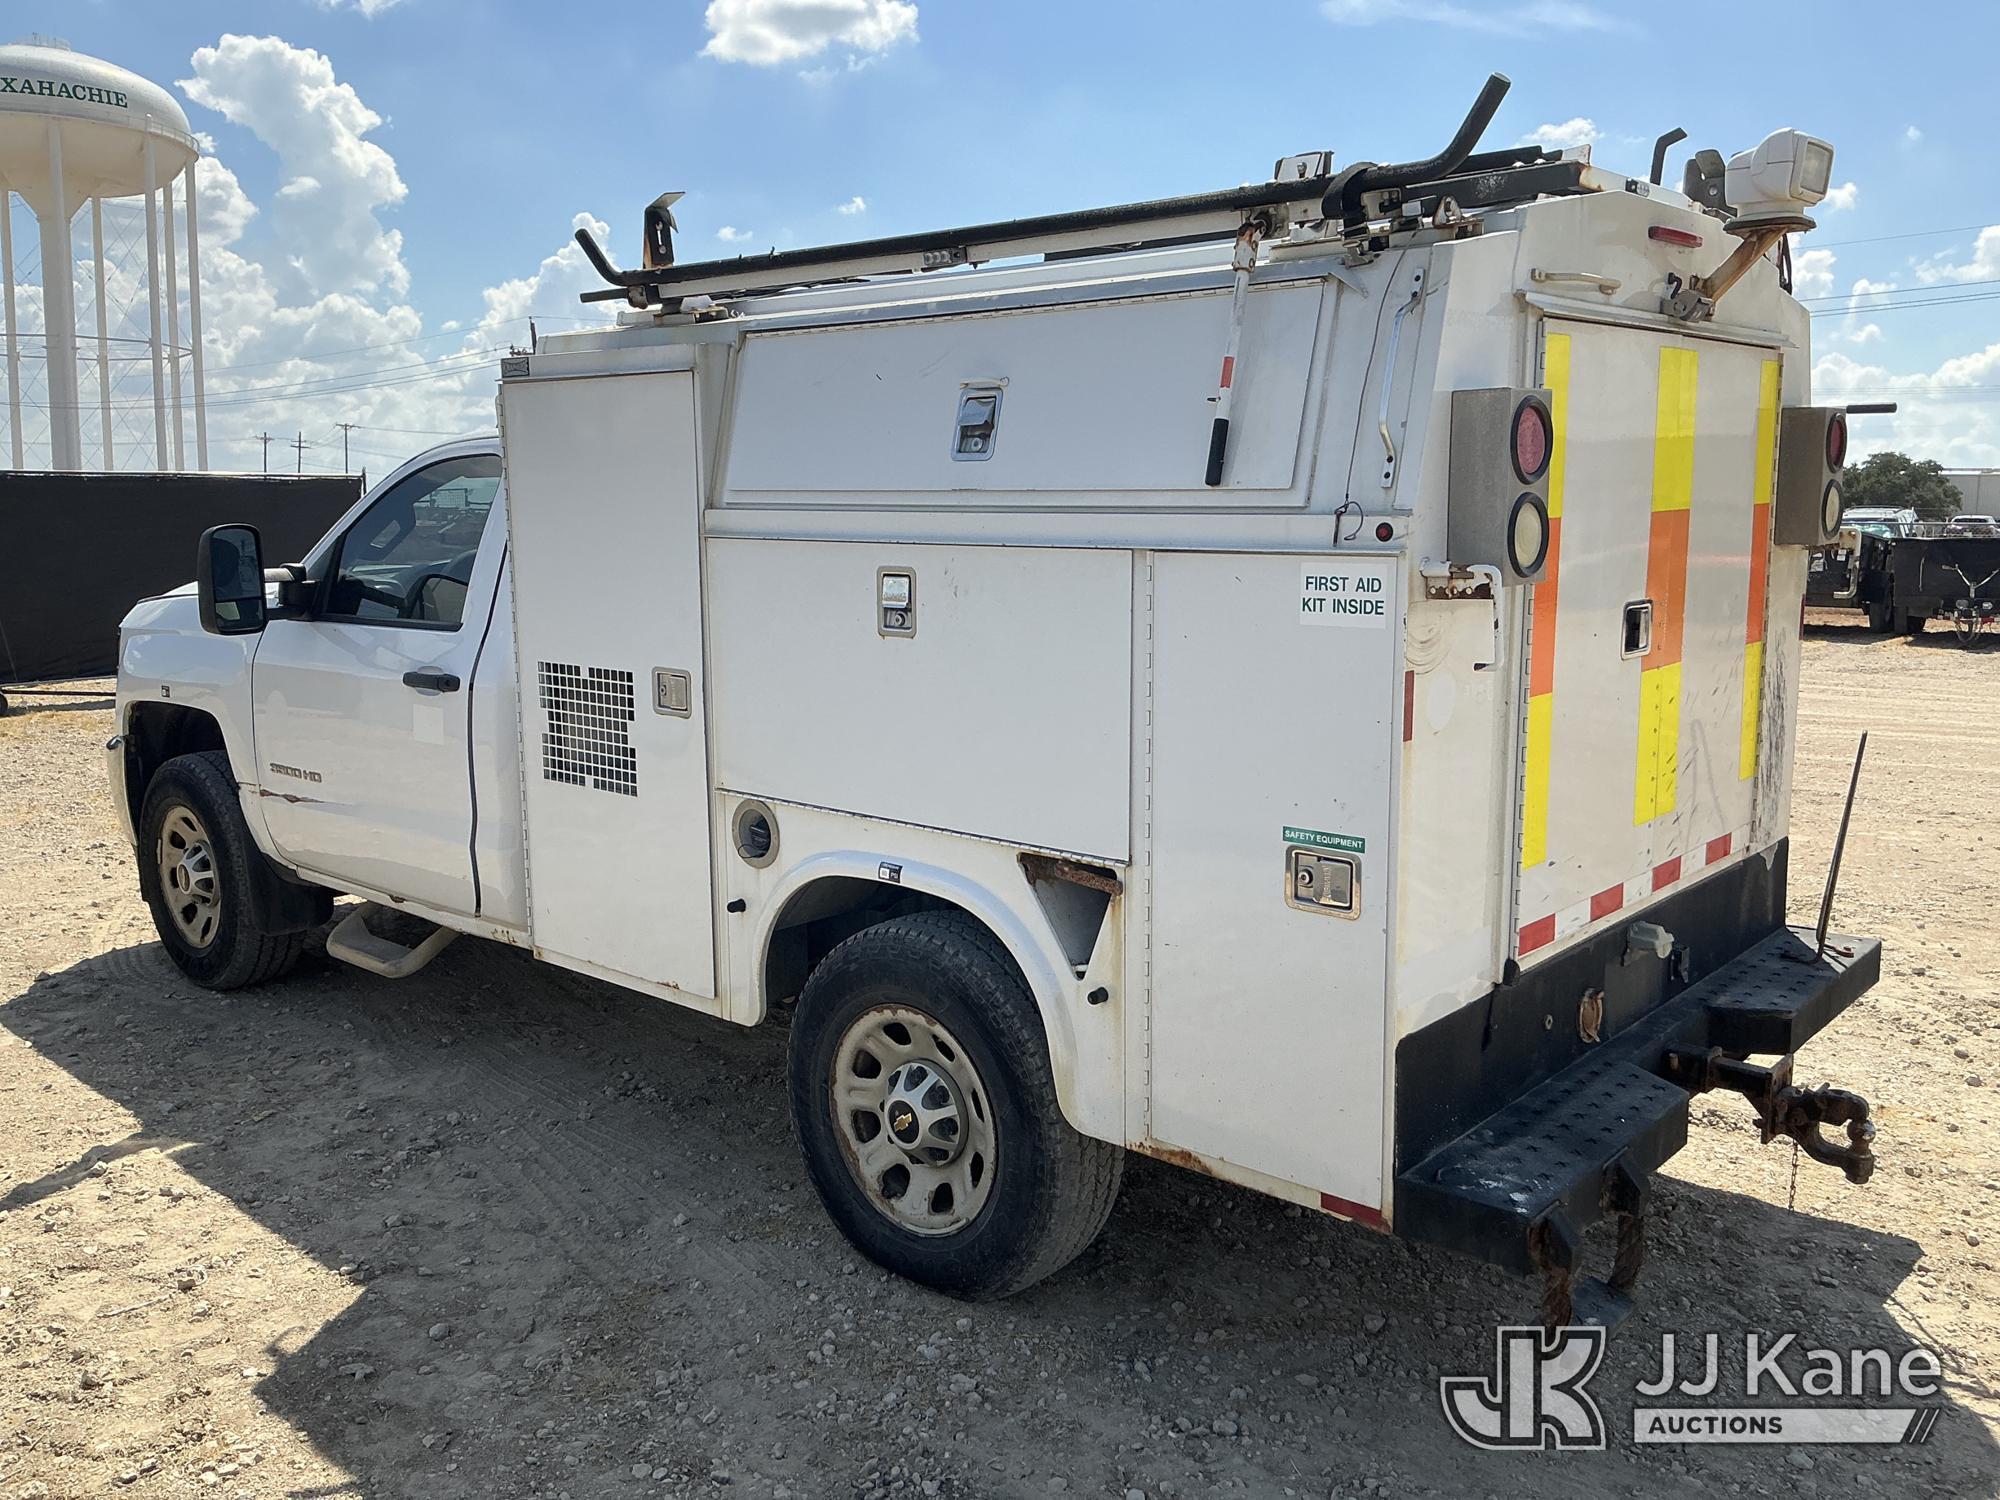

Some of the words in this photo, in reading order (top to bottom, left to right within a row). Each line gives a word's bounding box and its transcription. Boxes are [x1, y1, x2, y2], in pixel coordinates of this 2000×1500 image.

[0, 77, 128, 109] XAHACHIE
[1305, 576, 1349, 592] FIRST
[1355, 577, 1382, 593] AID
[1302, 597, 1326, 613] KIT
[1332, 598, 1385, 615] INSIDE
[302, 769, 322, 783] HD
[1284, 830, 1315, 841] SAFETY
[1316, 835, 1364, 849] EQUIPMENT
